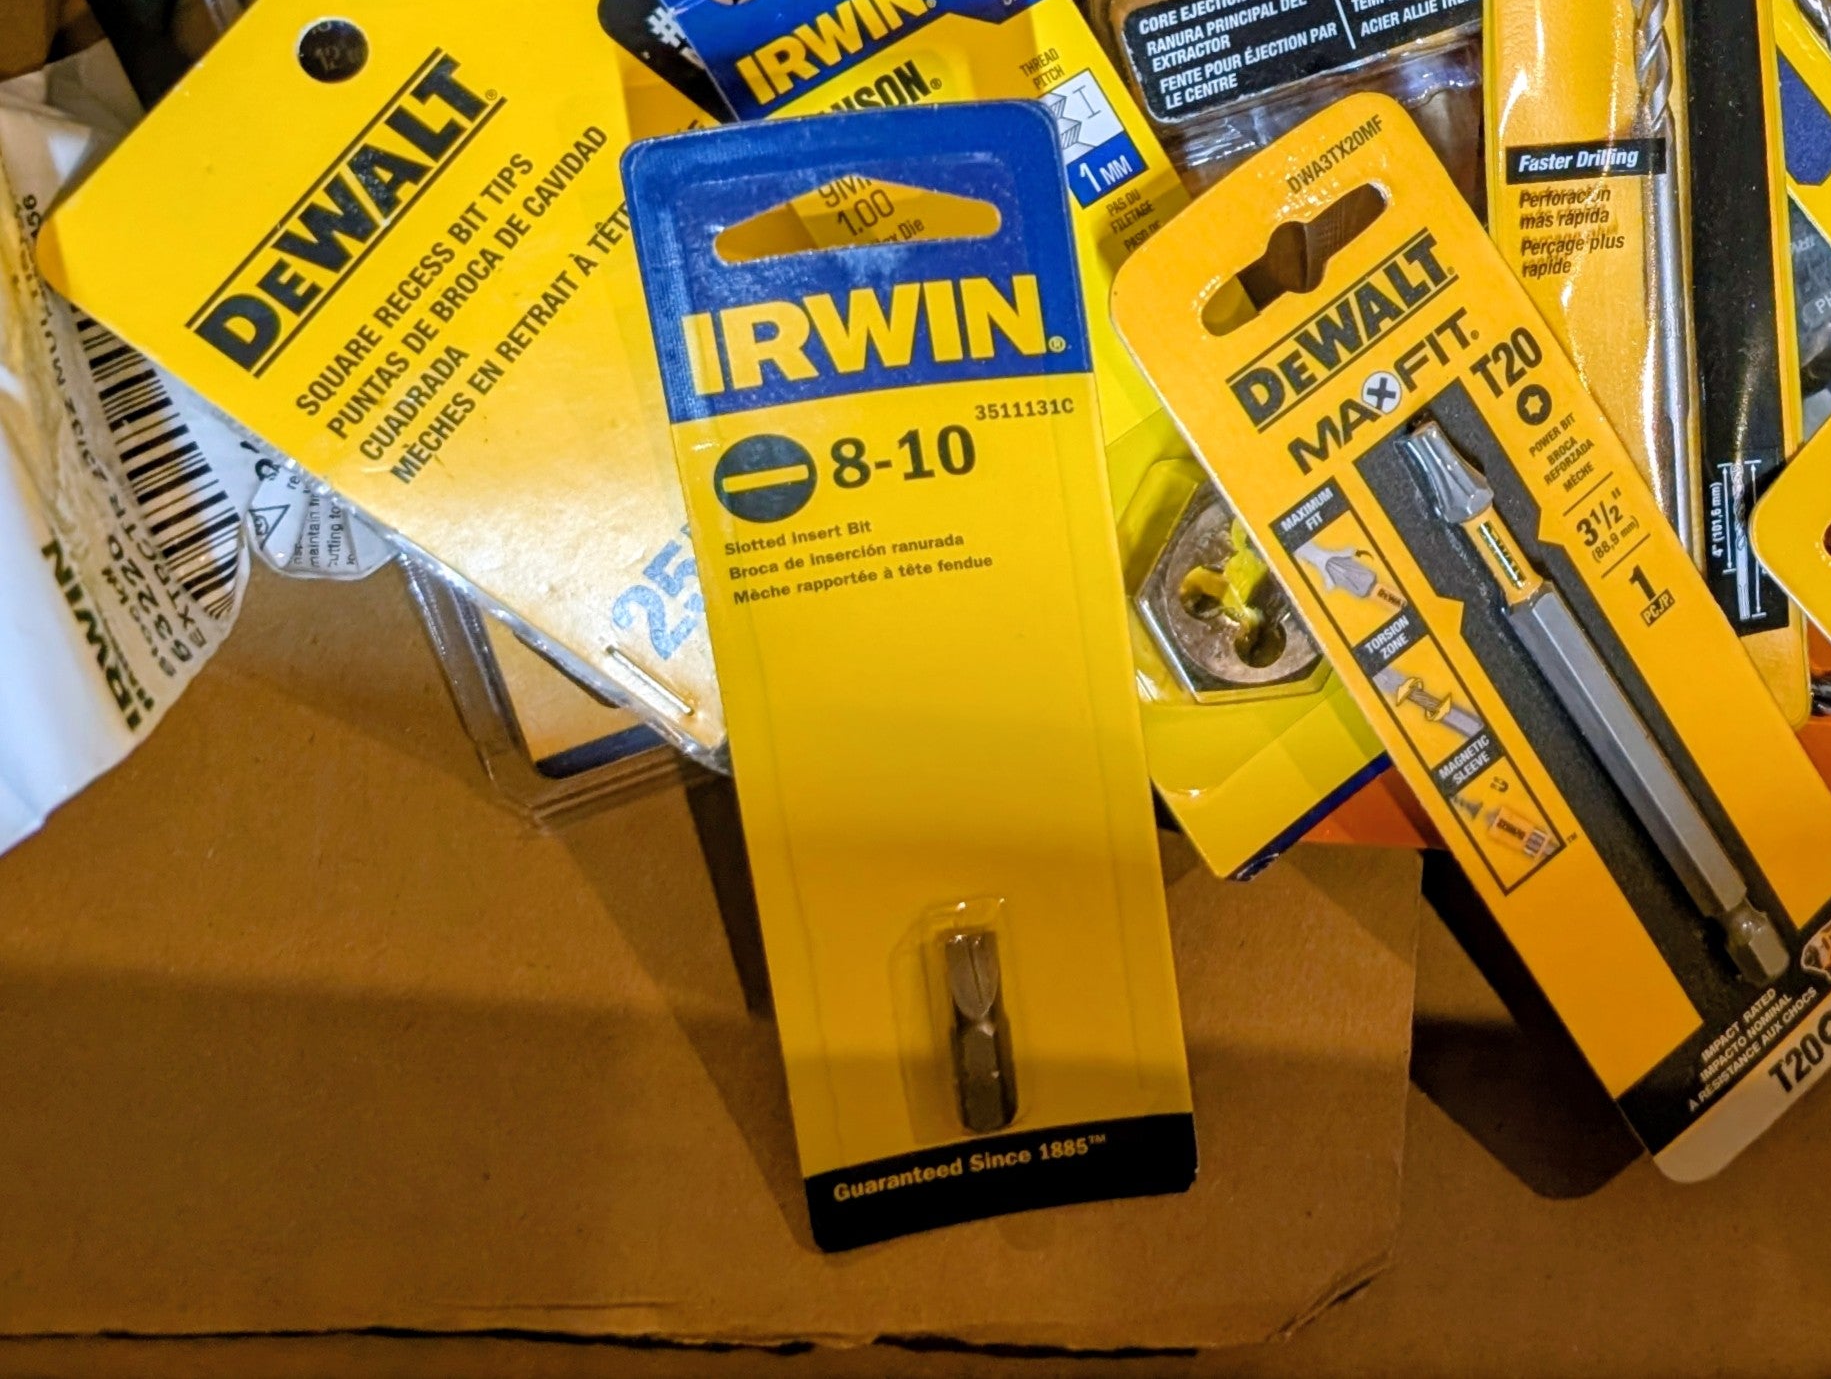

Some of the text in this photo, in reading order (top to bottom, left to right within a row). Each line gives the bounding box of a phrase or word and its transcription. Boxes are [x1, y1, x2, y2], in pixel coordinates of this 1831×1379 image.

[1139, 9, 1178, 35] CORE
[1146, 2, 1279, 56] RANURA PRINCIPAL
[1360, 12, 1401, 37] ACIER
[1152, 35, 1231, 73] EXTRACTOR
[1159, 54, 1242, 94] FENTE POUR
[1184, 73, 1238, 102] CENTRE
[1286, 113, 1385, 196] DWA3TX20MF
[1518, 151, 1574, 173] Faster
[194, 54, 494, 373] DEWALT
[837, 188, 895, 237] 1.00
[1589, 232, 1625, 255] plus
[295, 152, 535, 417] SQUARE RECESS BIT TIPS
[326, 125, 608, 441] PUNTAS DE BROCA DE CAVIDAD
[1521, 257, 1572, 279] rapide
[1228, 230, 1452, 430] DEWALT
[388, 269, 580, 485] MÈCHES EN RETRAIT
[1468, 325, 1544, 400] T20
[358, 344, 471, 461] CUADRADA
[974, 398, 1075, 421] 3511131C
[829, 424, 977, 490] 8-10
[1543, 438, 1595, 486] REFORZADA
[1280, 487, 1334, 532] MAXIMUM
[724, 520, 872, 557] Slotted Insert Bit
[728, 533, 965, 582] Broca inserción ranurada
[796, 553, 993, 595] rapportée tête fendue
[1628, 565, 1658, 602] 1
[1364, 615, 1410, 655] TORSION
[1380, 632, 1409, 660] ZONE
[1437, 734, 1491, 781] MAGNETIC
[1452, 753, 1491, 787] SLEEVE
[1699, 994, 1793, 1082] IMPACTO NOMINAL
[1700, 987, 1777, 1061] IMPACT RATED
[1761, 986, 1818, 1047] AUX CHOCS
[833, 1158, 963, 1203] Guaranteed
[969, 1147, 1032, 1173] Since
